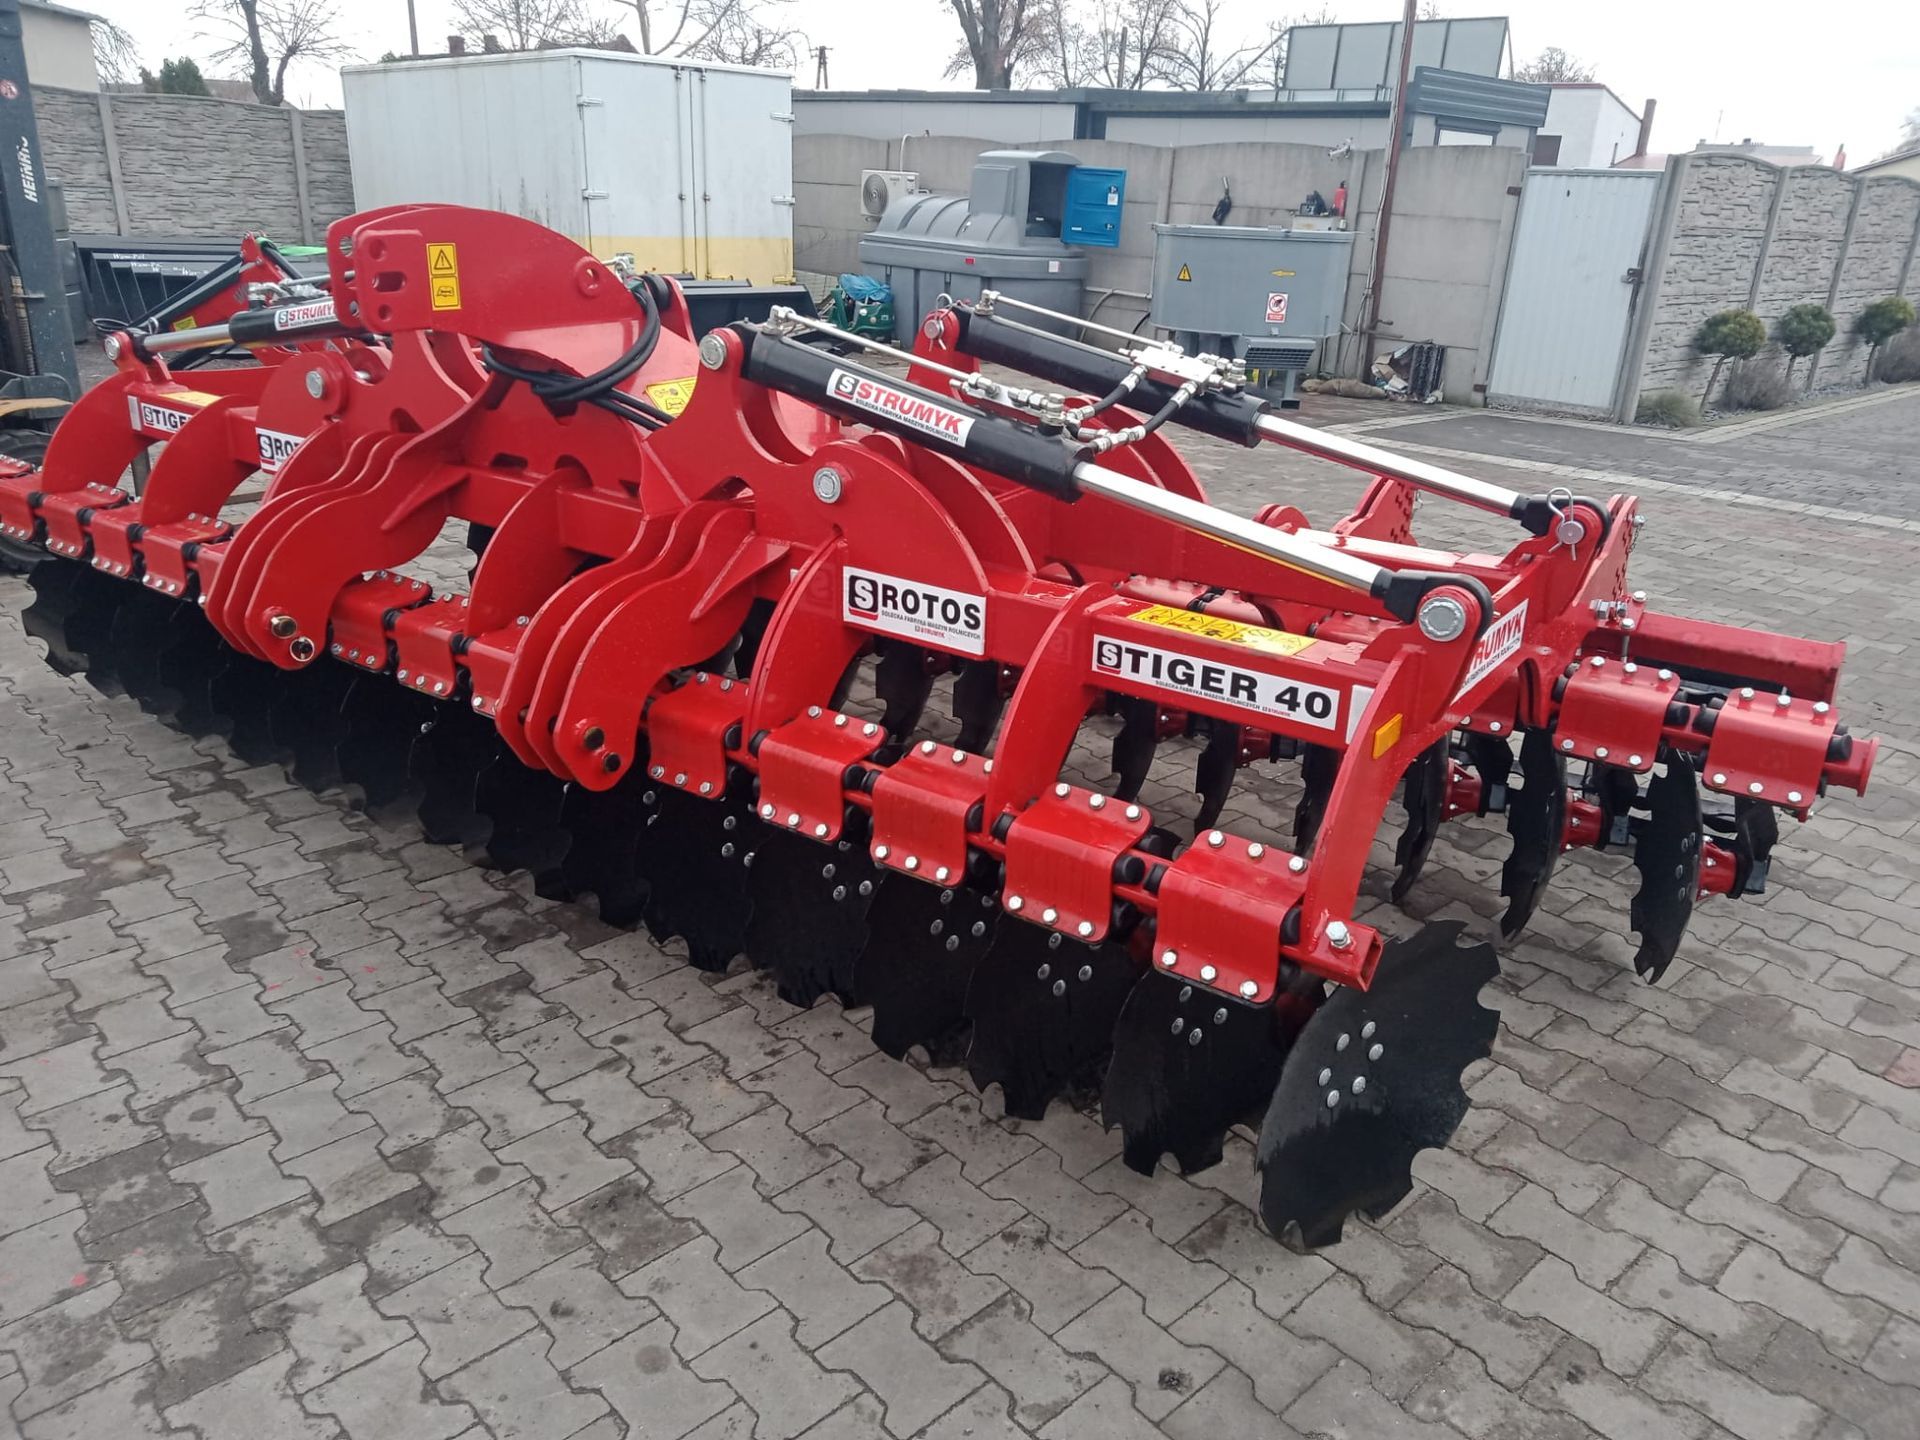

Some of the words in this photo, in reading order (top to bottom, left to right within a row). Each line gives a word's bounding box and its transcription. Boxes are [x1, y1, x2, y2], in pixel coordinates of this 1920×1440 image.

[289, 303, 336, 322] STRUMY
[152, 408, 191, 429] TIGE
[856, 381, 965, 435] STRUMYK
[273, 437, 300, 457] RO
[881, 583, 981, 631] ROTOS
[1471, 607, 1526, 672] RUMYK
[1125, 648, 1259, 703] TIGER
[1274, 685, 1332, 720] 40
